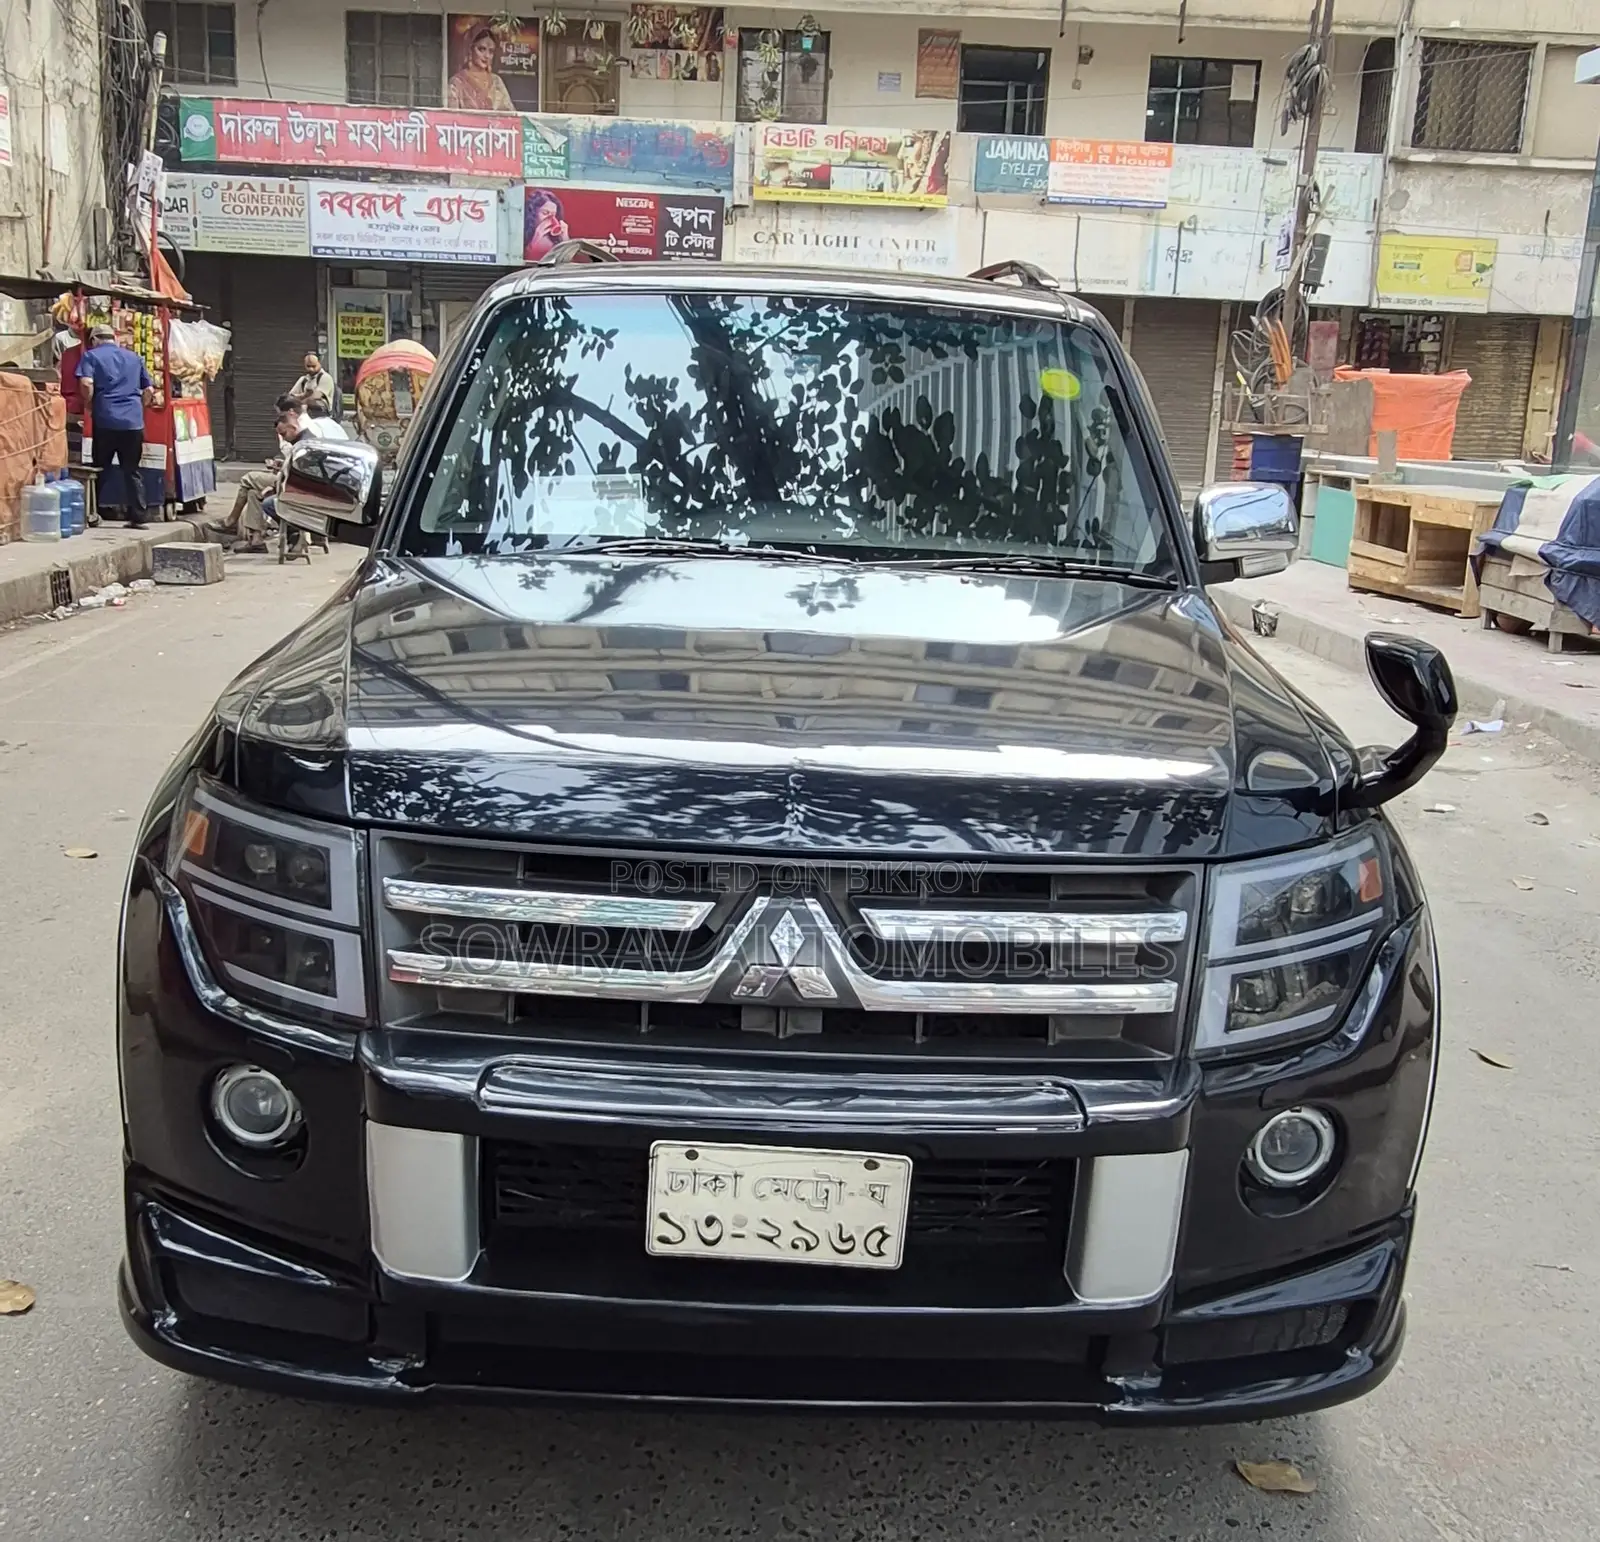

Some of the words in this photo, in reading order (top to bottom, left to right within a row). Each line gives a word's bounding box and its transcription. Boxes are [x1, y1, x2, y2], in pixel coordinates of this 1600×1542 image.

[218, 110, 282, 145] দারুল
[286, 106, 339, 157] উলূম
[343, 111, 429, 154] মহাখালী
[763, 126, 818, 148] বিউটি
[985, 139, 1048, 162] JAMUNA
[1055, 153, 1078, 162] Mr.
[1085, 154, 1093, 164] J
[1098, 154, 1111, 164] R
[1115, 155, 1167, 167] House
[1000, 162, 1043, 176] EYELET
[220, 181, 304, 195] JALIL
[221, 192, 305, 207] ENGINEERING
[317, 190, 407, 220] নবরূপ
[221, 204, 305, 218] COMPANY
[665, 206, 716, 231] স্বপন
[665, 230, 680, 248] টি
[682, 231, 716, 250] স্টোর
[753, 231, 795, 245] CAR
[803, 233, 861, 249] LIGHT
[667, 1168, 745, 1199] ঢাকা
[656, 1211, 893, 1259] ১৩-২৯৬৫
